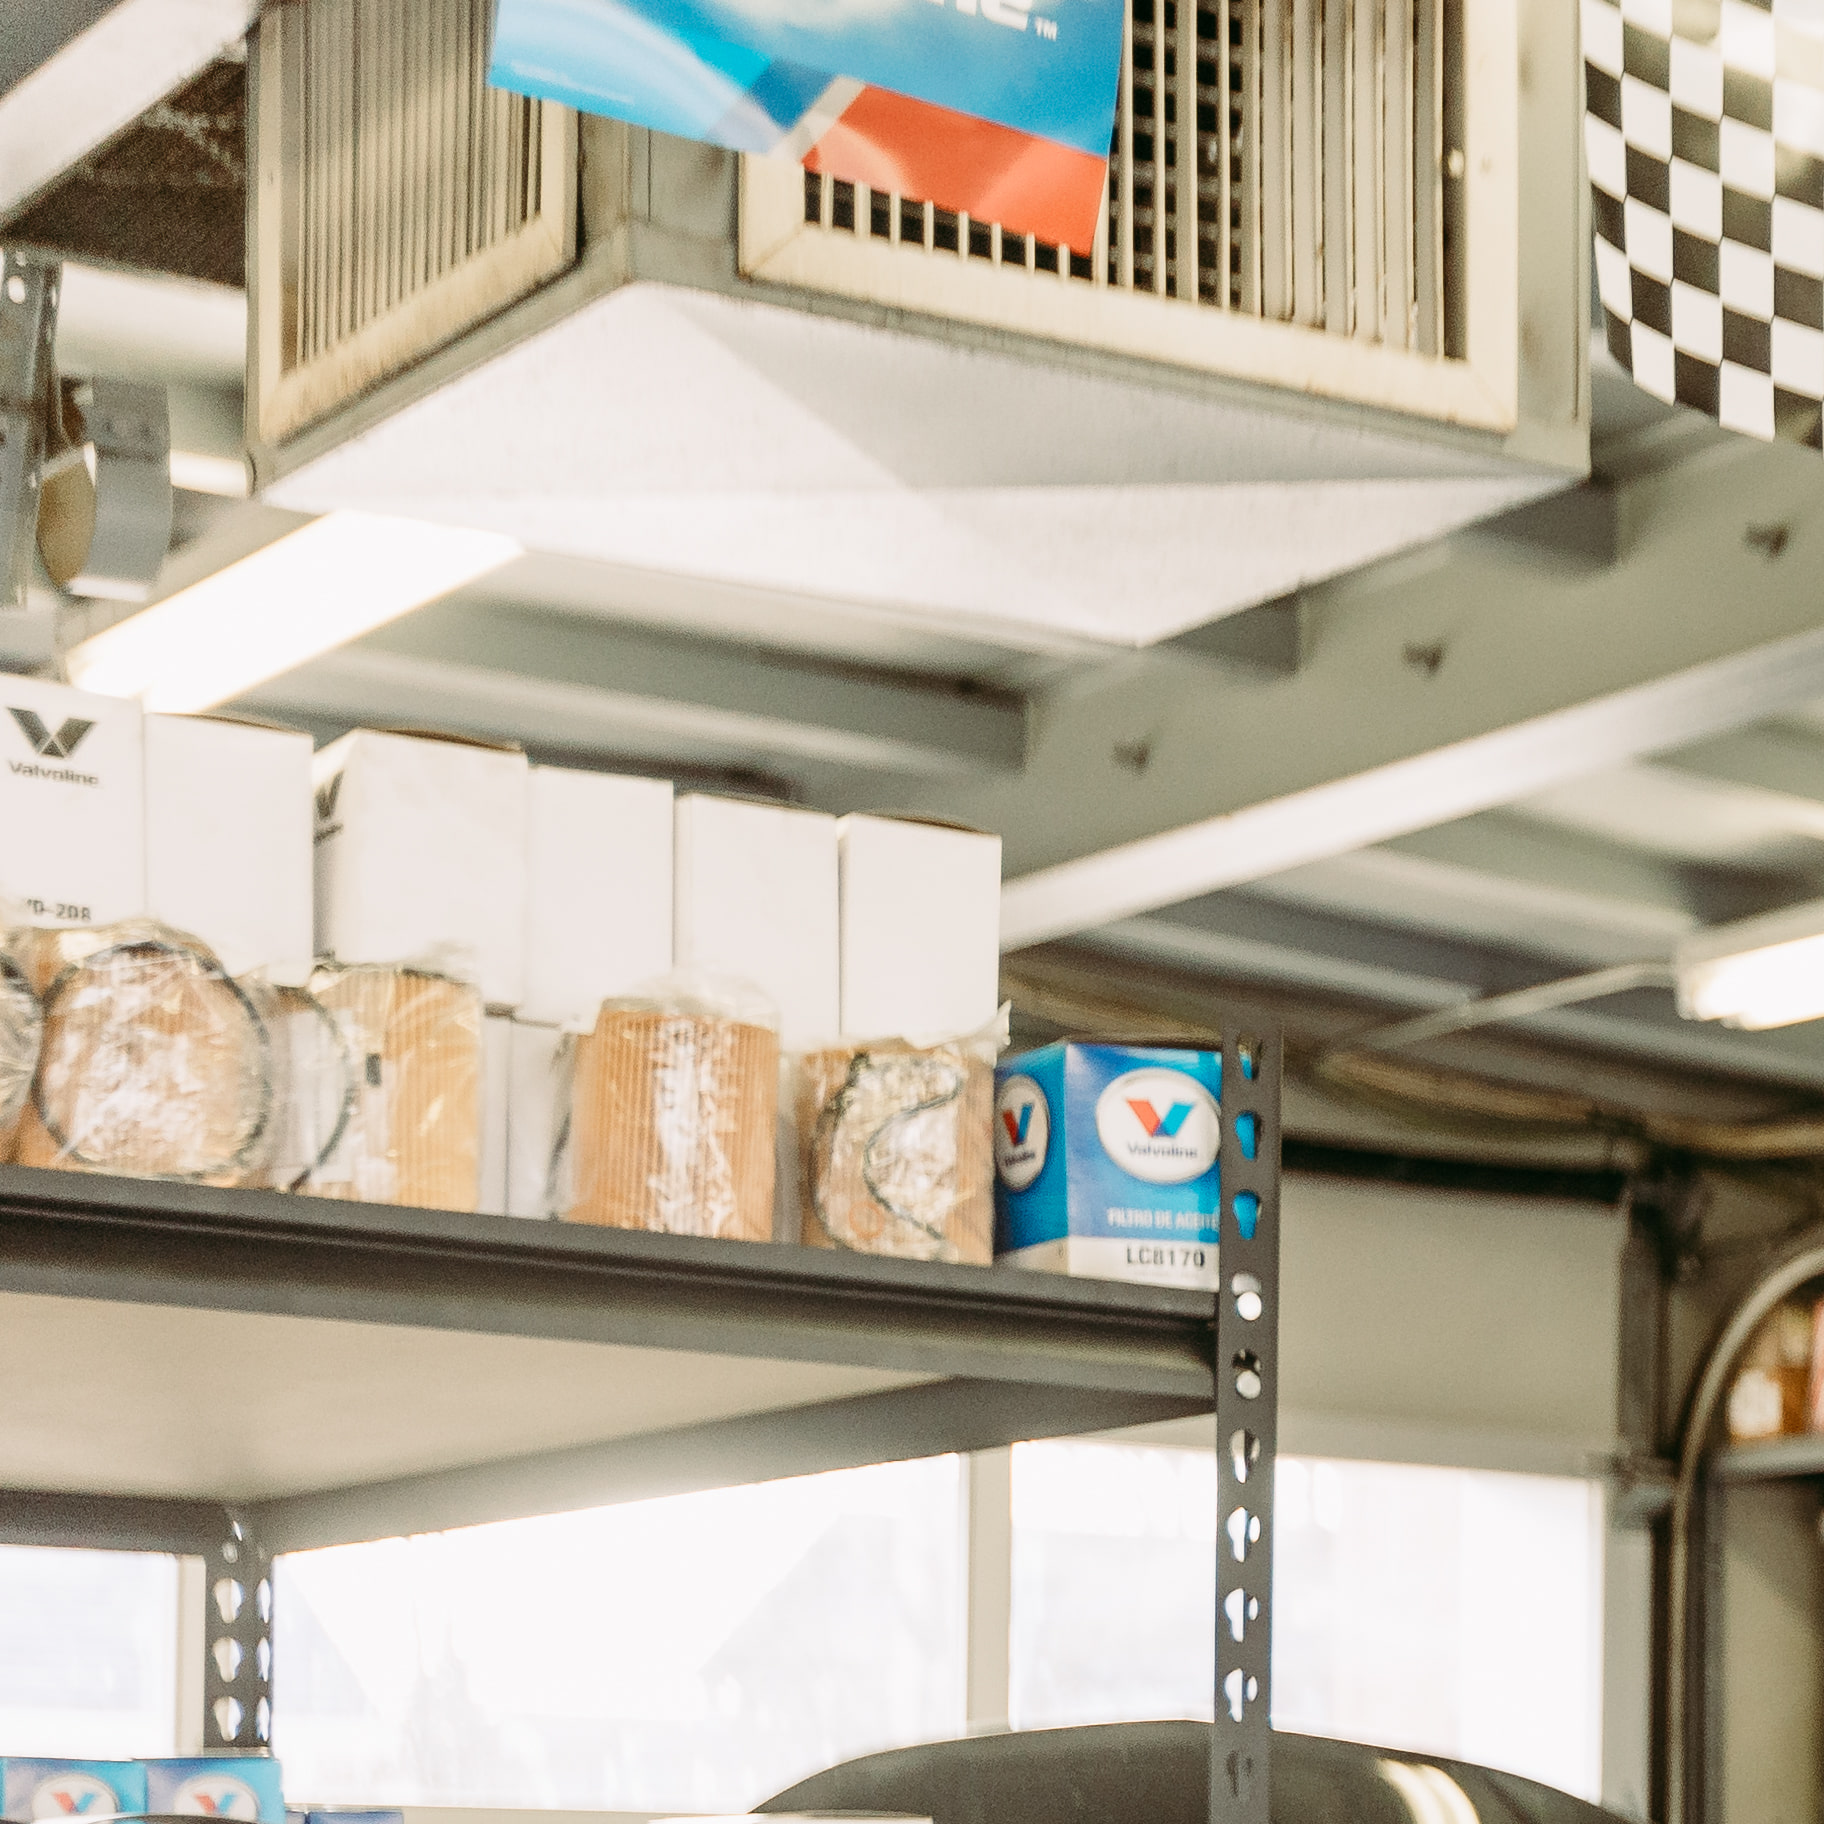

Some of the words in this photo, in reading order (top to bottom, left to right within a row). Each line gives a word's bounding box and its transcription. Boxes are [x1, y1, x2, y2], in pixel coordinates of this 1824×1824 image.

[7, 759, 99, 787] Valvoline
[26, 897, 92, 922] O-208
[1127, 1140, 1199, 1159] Valvoline
[1107, 1206, 1153, 1228] FILTRO
[1155, 1209, 1173, 1229] DE
[1125, 1244, 1206, 1268] LC8170
